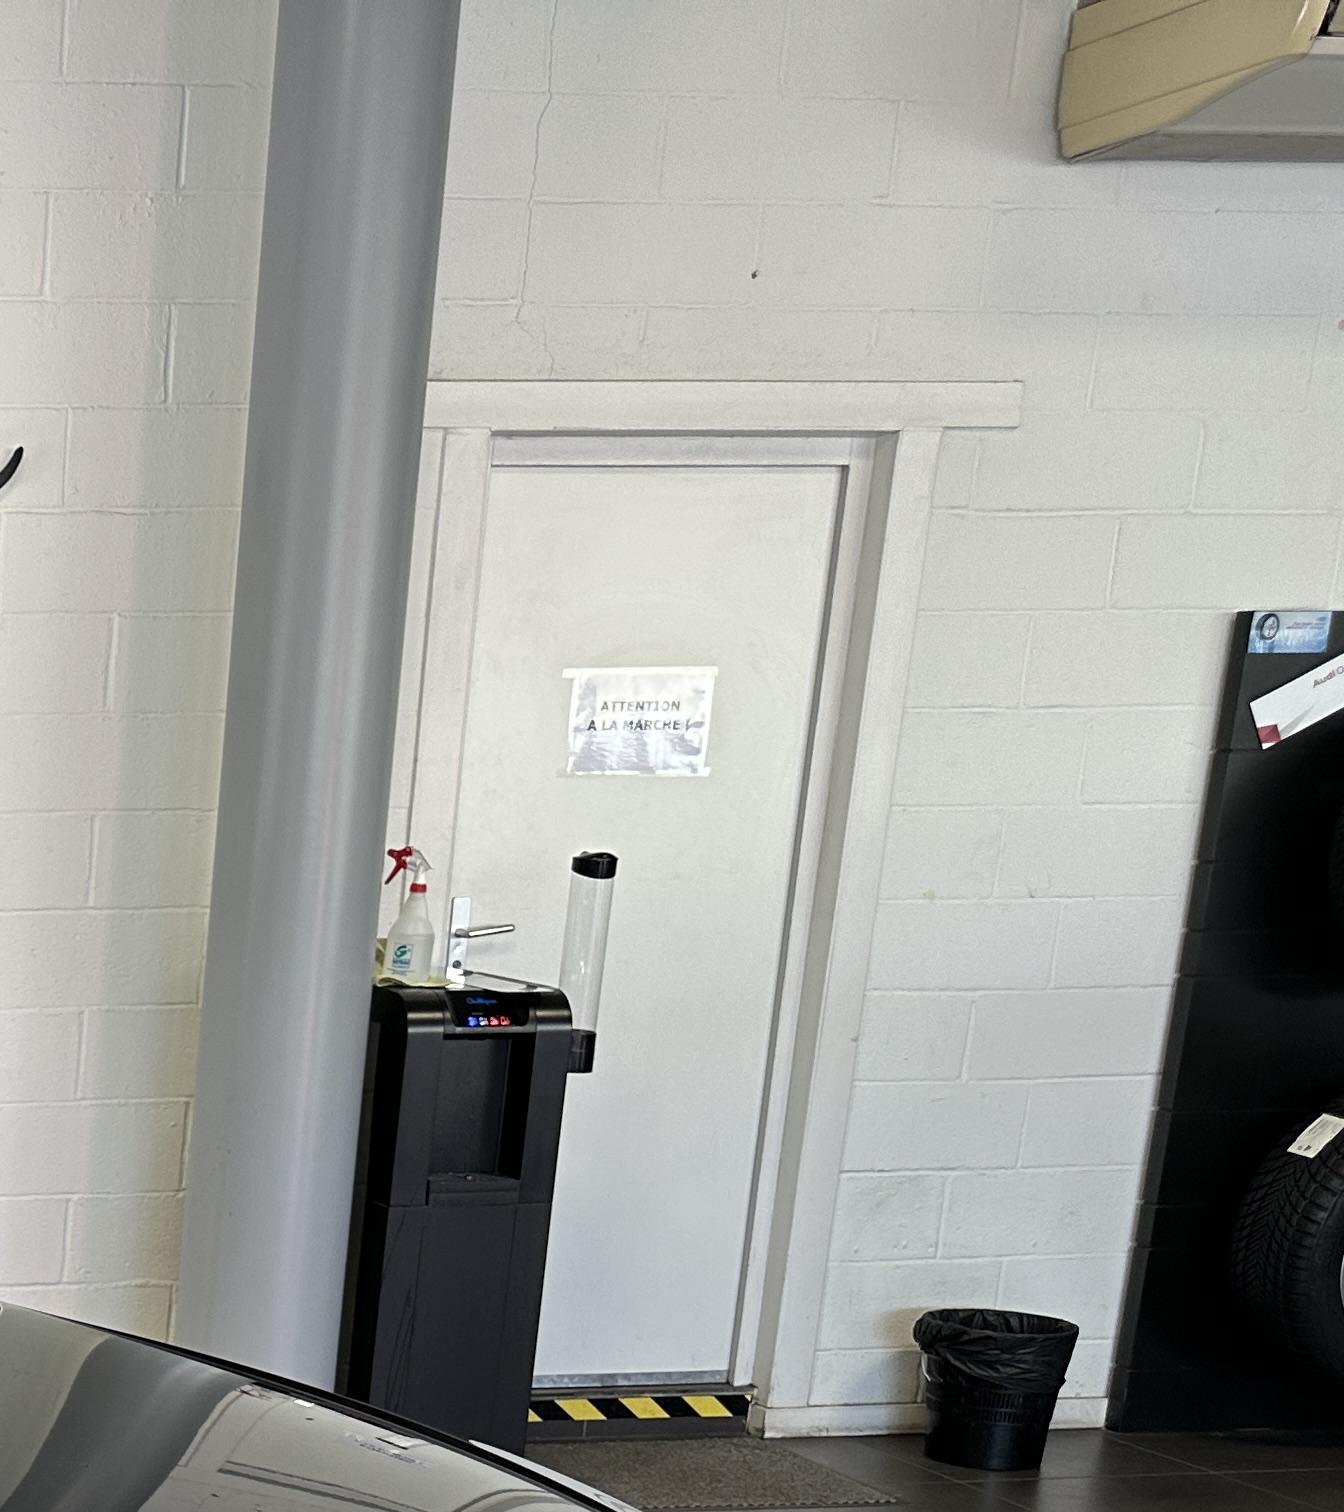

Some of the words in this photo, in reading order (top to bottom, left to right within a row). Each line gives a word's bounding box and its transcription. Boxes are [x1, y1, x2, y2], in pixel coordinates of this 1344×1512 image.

[600, 700, 681, 713] ATTENTION
[587, 718, 597, 732] A
[601, 719, 618, 732] LA
[623, 718, 681, 733] MARCHE
